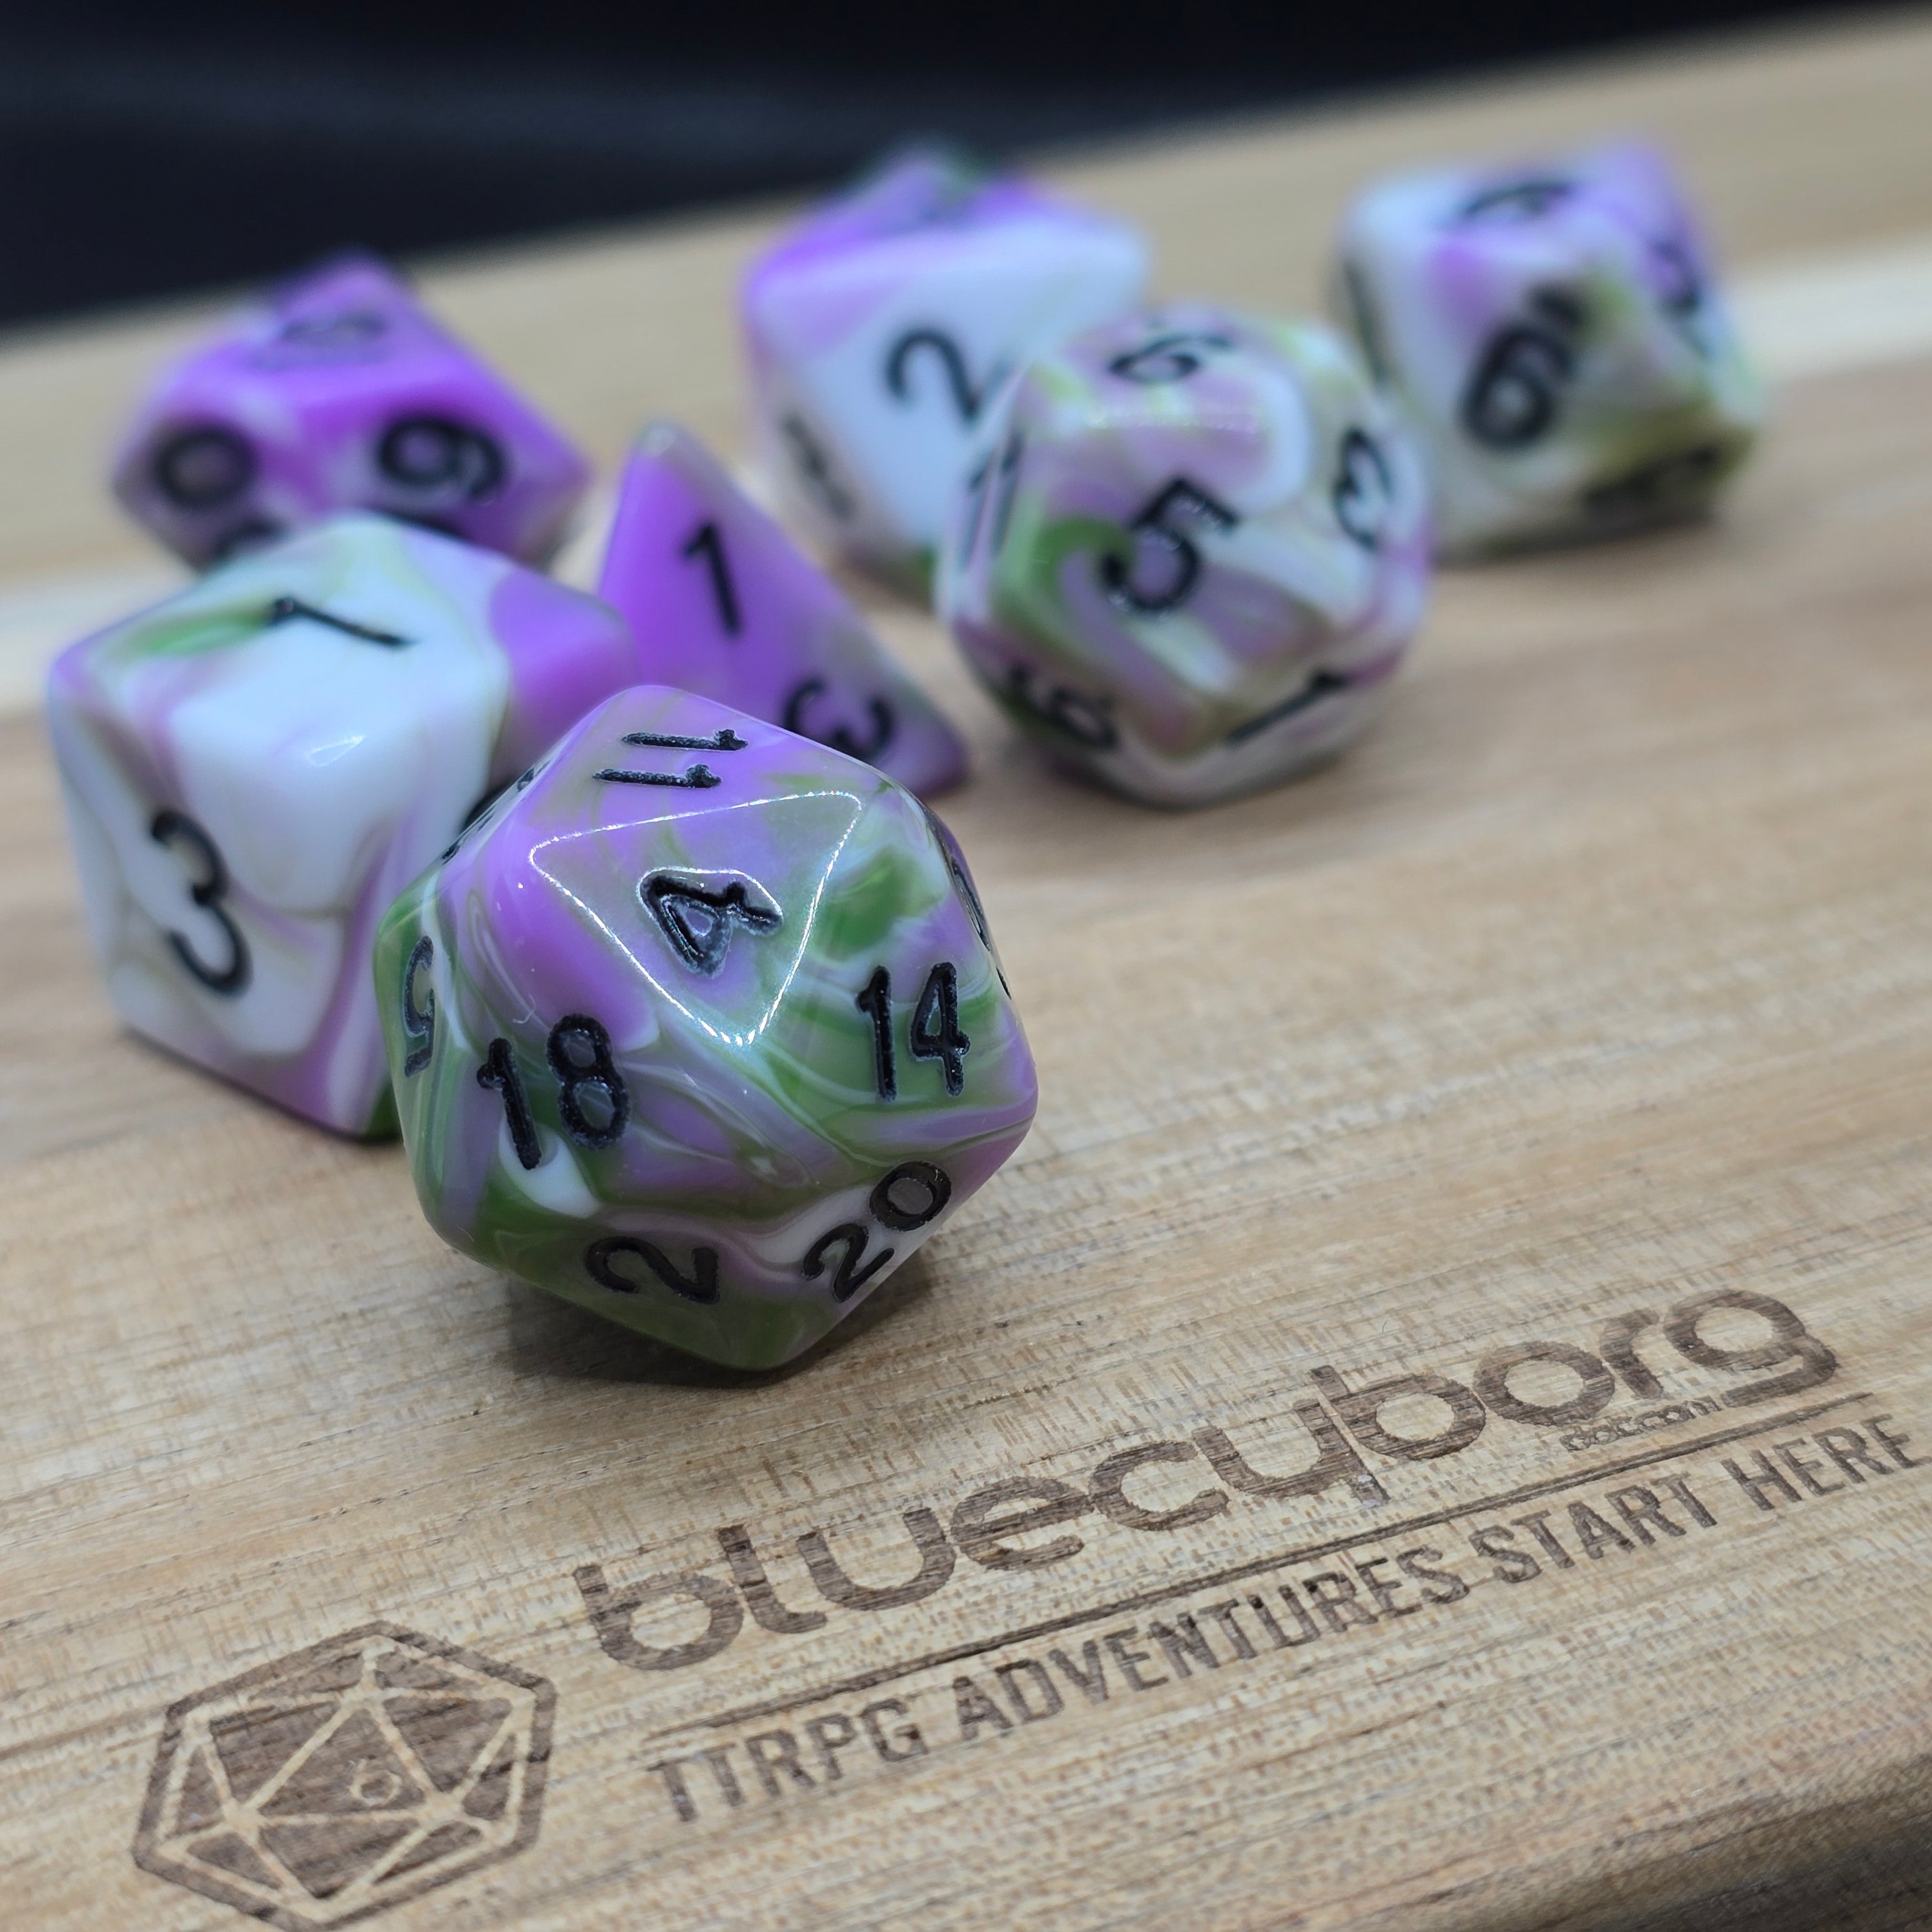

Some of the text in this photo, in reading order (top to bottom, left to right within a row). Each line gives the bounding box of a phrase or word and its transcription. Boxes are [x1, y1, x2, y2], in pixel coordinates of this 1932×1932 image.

[885, 328, 1009, 423] 2
[683, 522, 743, 639] 1
[1100, 473, 1241, 616] 5
[592, 728, 749, 788] 11
[781, 678, 895, 763] 3
[1225, 668, 1351, 746] 1
[150, 810, 253, 997] 3
[639, 869, 784, 978] 4
[477, 1013, 631, 1170] 18
[856, 961, 971, 1103] 14
[584, 1237, 721, 1304] 2
[801, 1160, 952, 1303] 20
[571, 1290, 1838, 1671] bluecuborg
[647, 1413, 1931, 1822] TTRPG ADVENTURES START HERE
